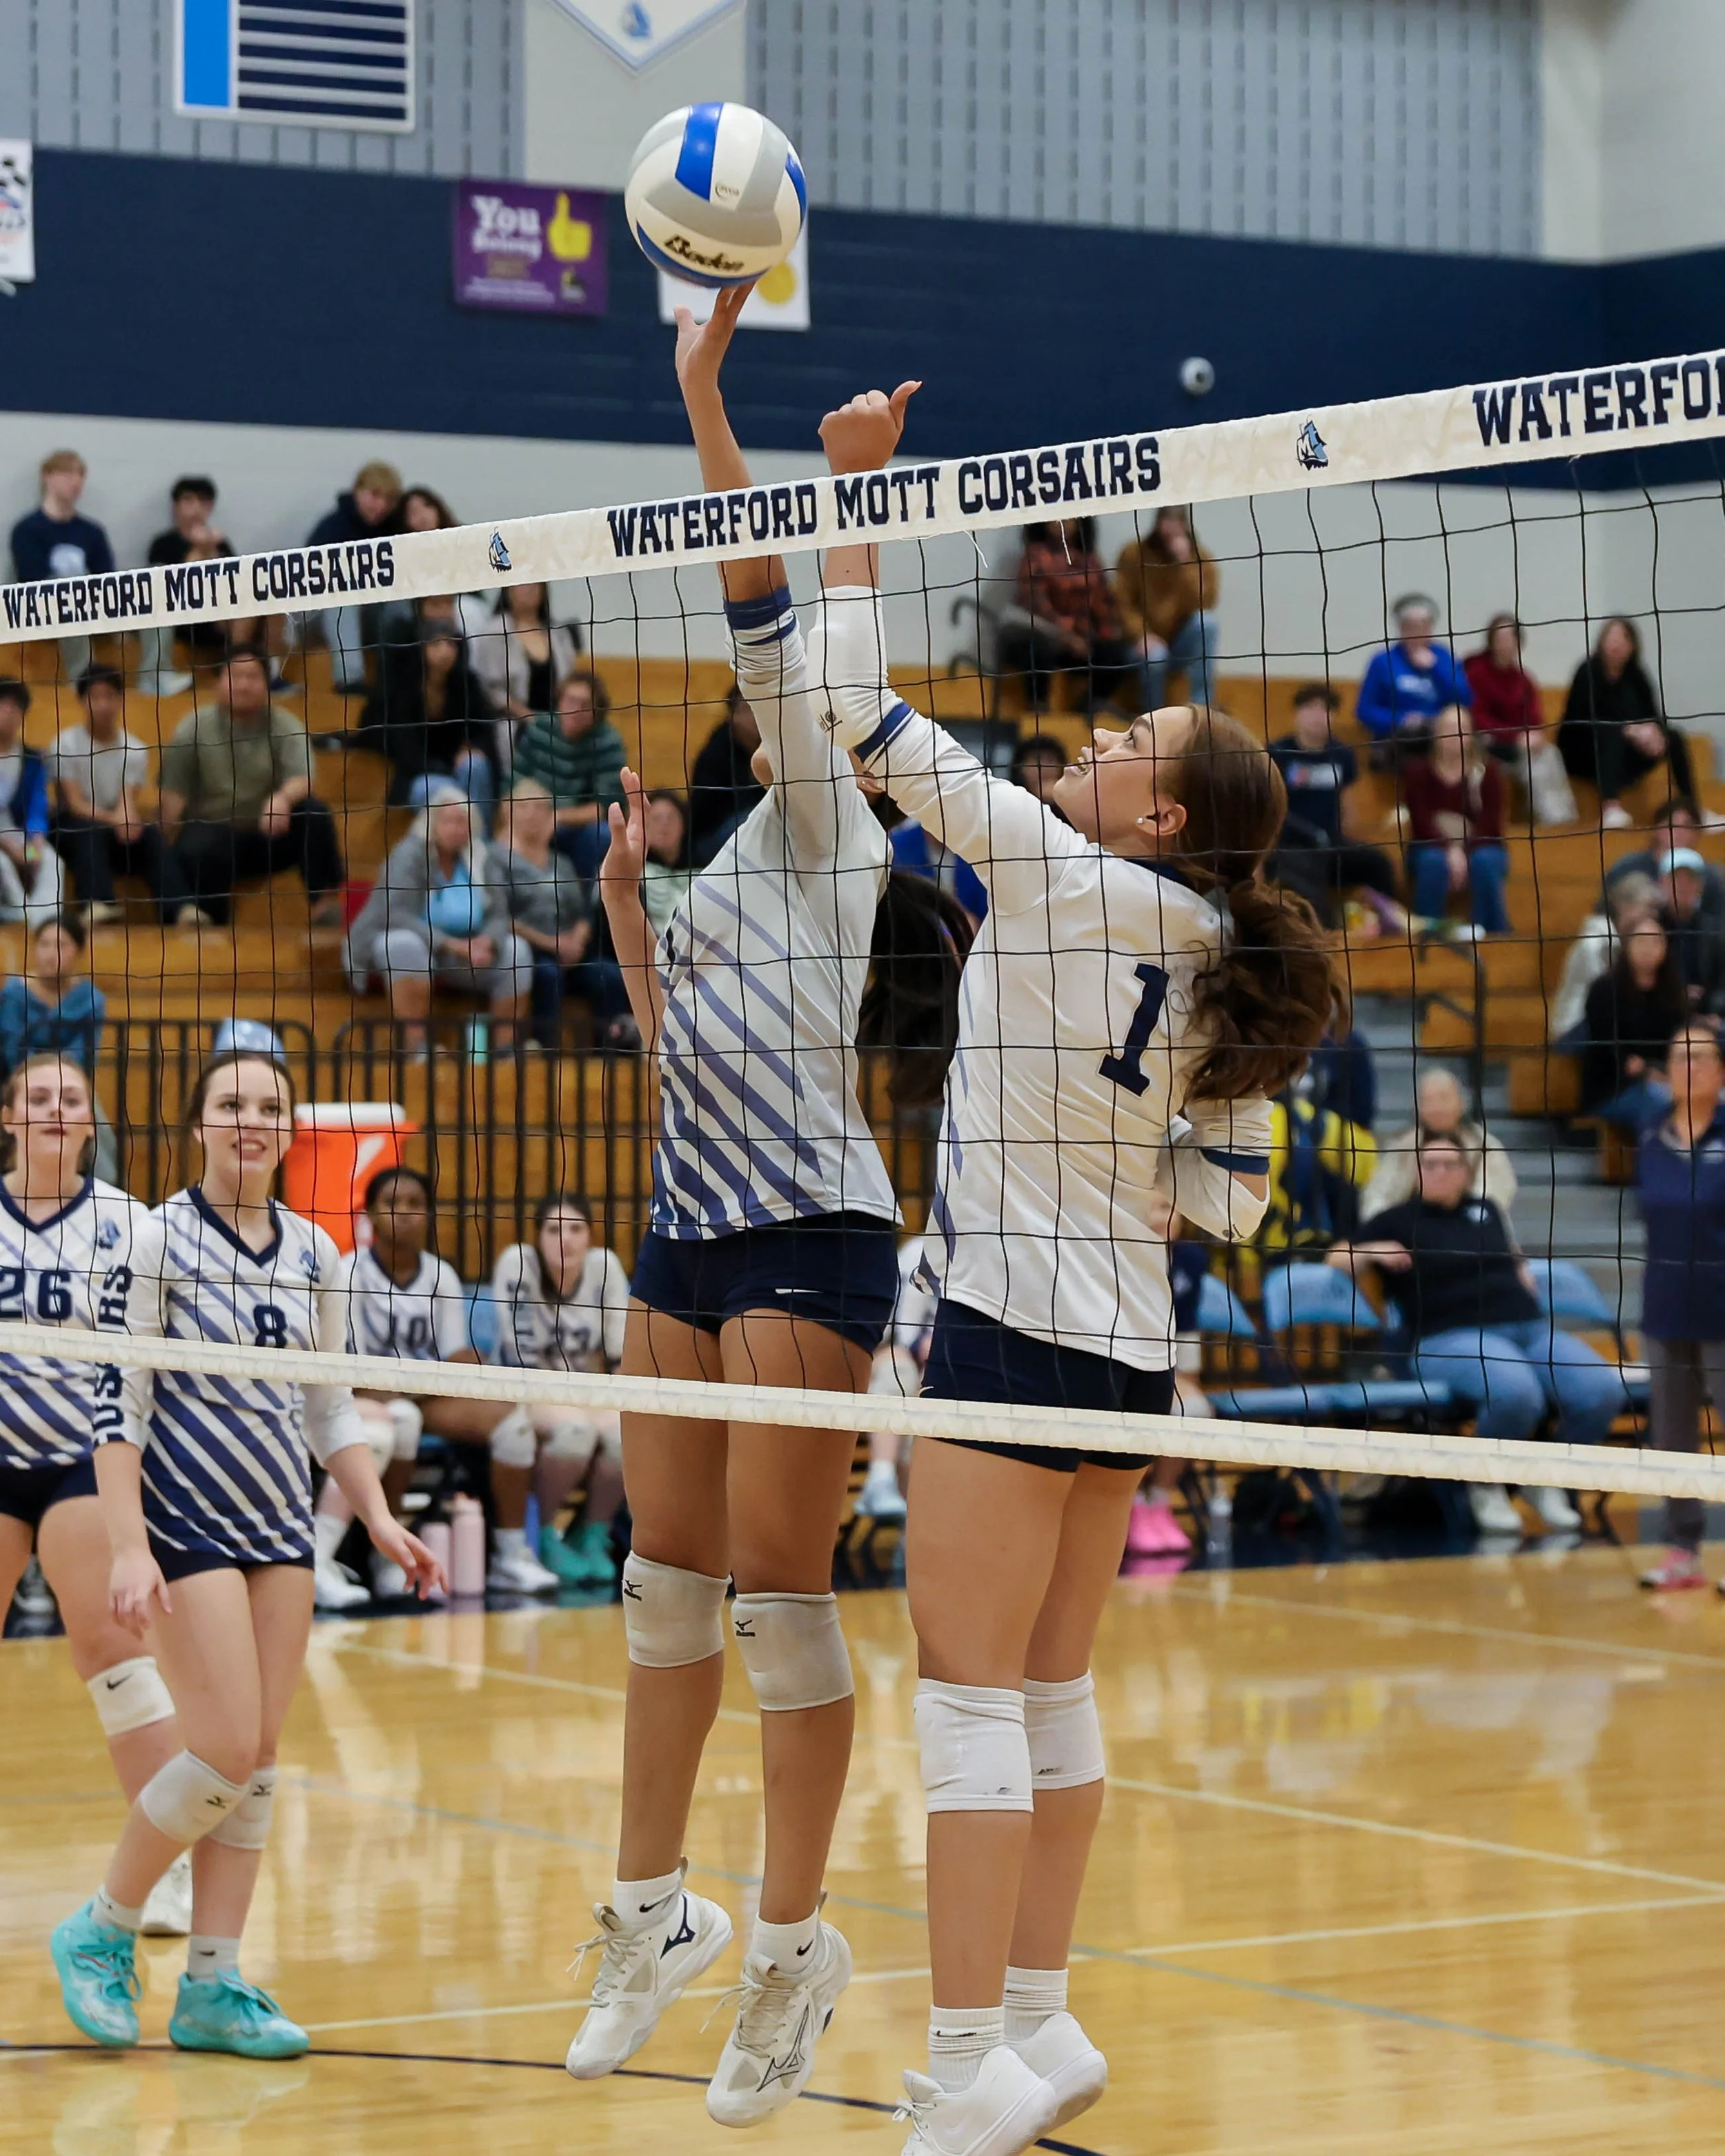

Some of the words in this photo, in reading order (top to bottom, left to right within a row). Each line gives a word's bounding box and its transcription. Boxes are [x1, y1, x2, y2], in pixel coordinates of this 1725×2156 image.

[471, 194, 541, 236] You
[607, 483, 818, 558] WATERFORD
[834, 466, 940, 530] MOTT
[958, 437, 1161, 515] CORSAIRS
[3, 573, 153, 629] WATERFORD
[166, 559, 240, 613] MOTT
[251, 540, 395, 602] CORSAIRS
[1096, 962, 1171, 1097] 1
[0, 1268, 72, 1321] 26
[253, 1304, 288, 1348] 8
